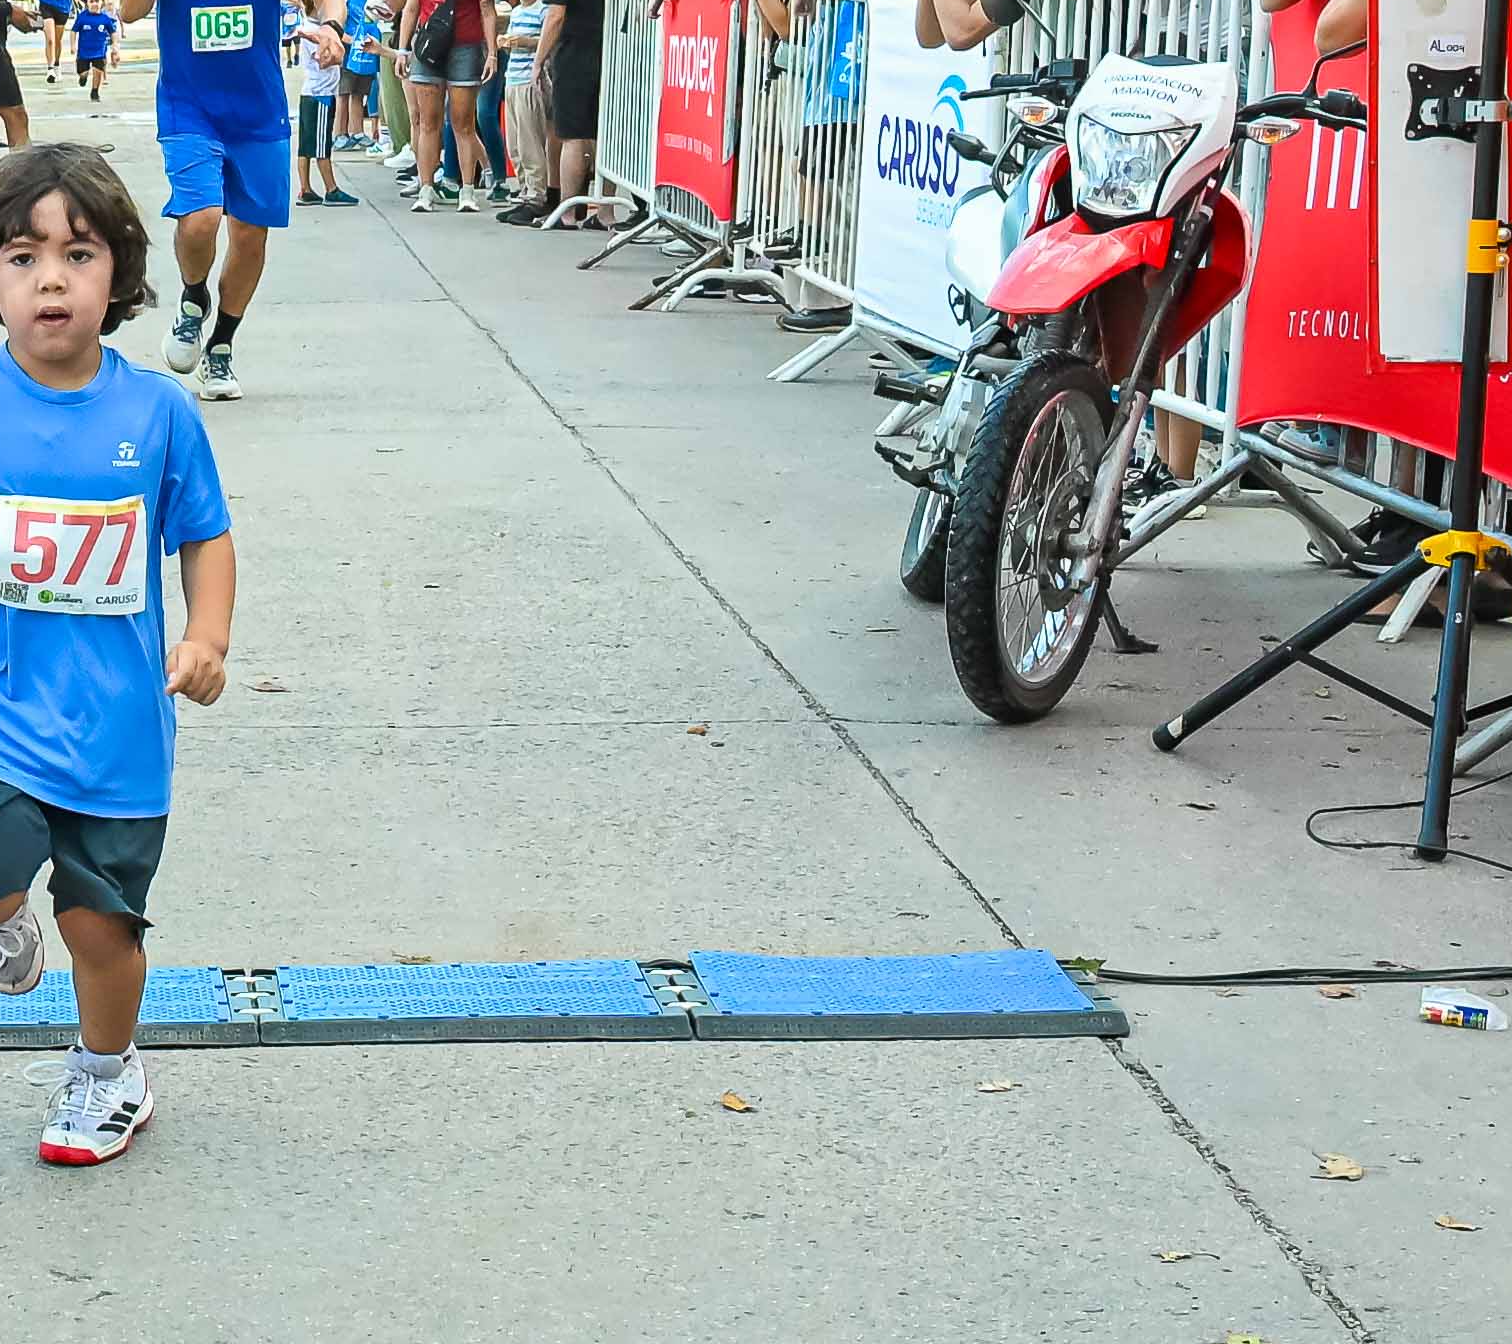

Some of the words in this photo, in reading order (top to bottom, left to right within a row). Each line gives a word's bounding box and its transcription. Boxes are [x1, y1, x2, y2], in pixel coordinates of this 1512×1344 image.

[195, 10, 250, 40] 065
[667, 14, 719, 110] moplex
[1110, 111, 1152, 121] HONDA
[877, 114, 960, 198] CARUSO
[1288, 309, 1368, 341] TECNOL
[11, 510, 137, 586] 577
[95, 593, 138, 605] CARUSO
